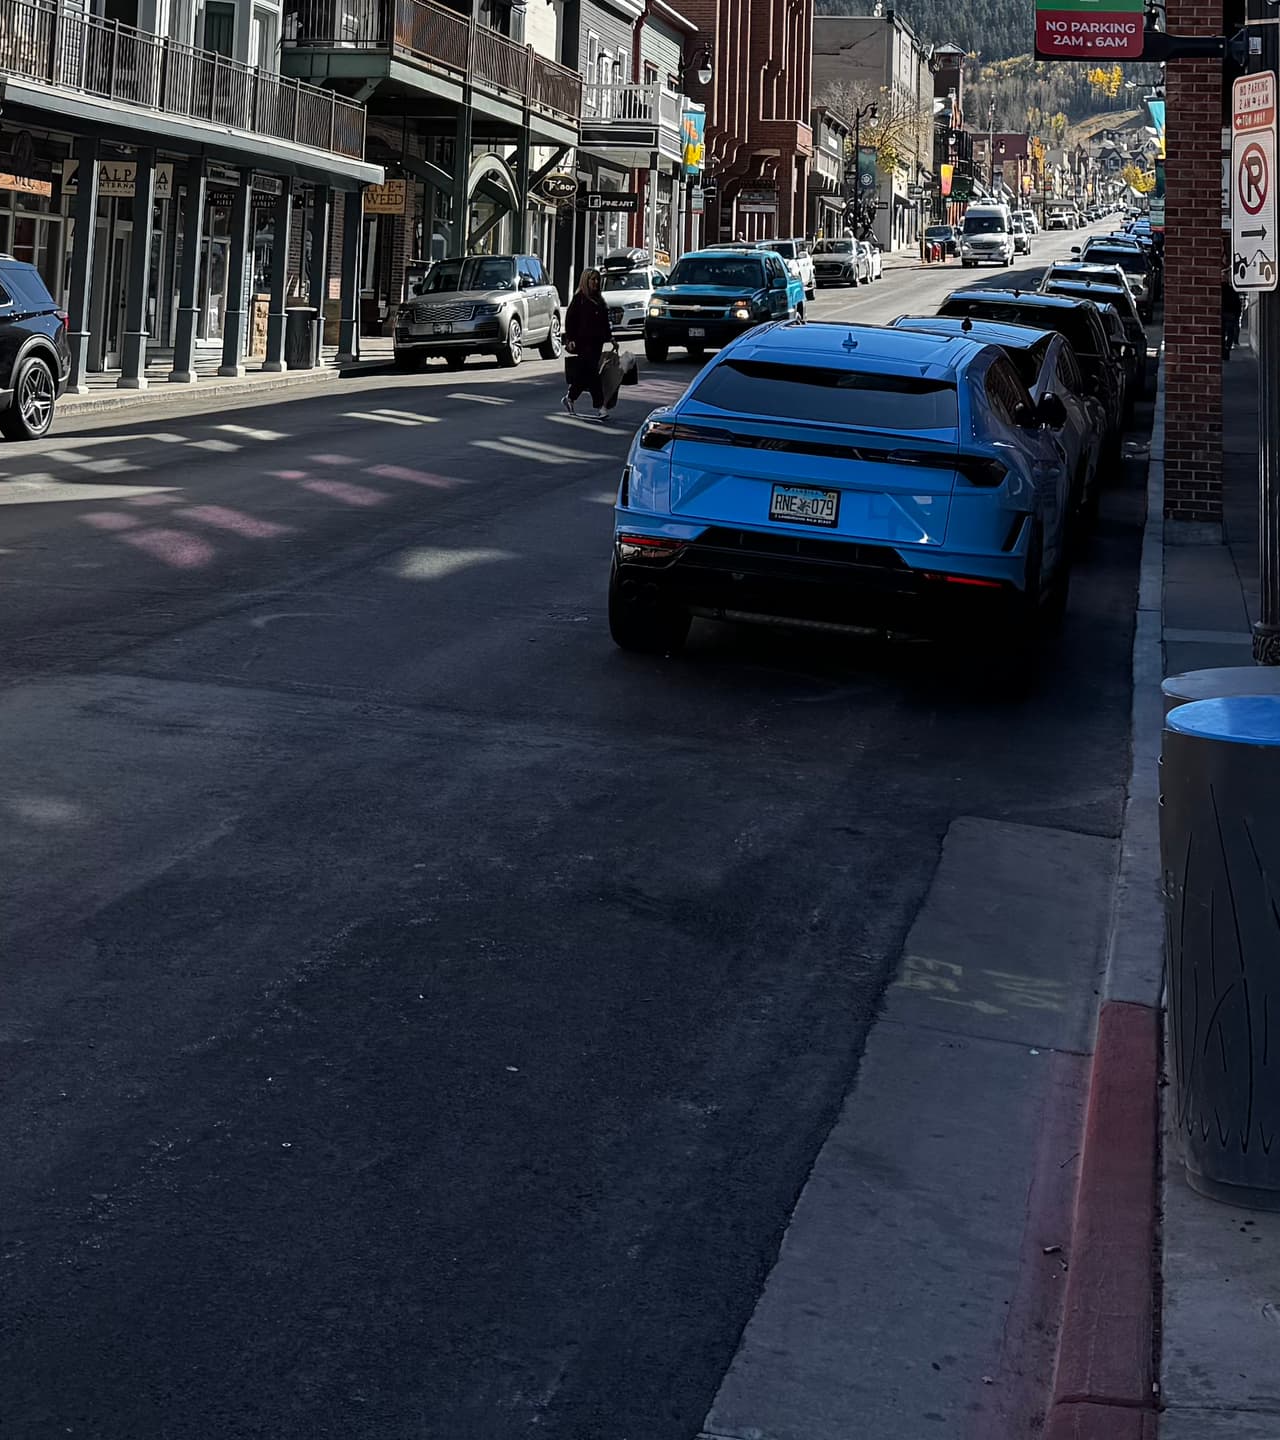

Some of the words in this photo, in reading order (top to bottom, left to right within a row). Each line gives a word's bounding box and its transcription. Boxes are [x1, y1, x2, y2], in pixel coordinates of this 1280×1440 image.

[1045, 20, 1068, 32] NO
[1071, 21, 1136, 33] PARKING
[1053, 34, 1084, 46] 2AM
[1095, 36, 1127, 47] 6AM
[1248, 80, 1268, 95] PARKING
[775, 495, 799, 512] RNE
[812, 498, 834, 516] 079
